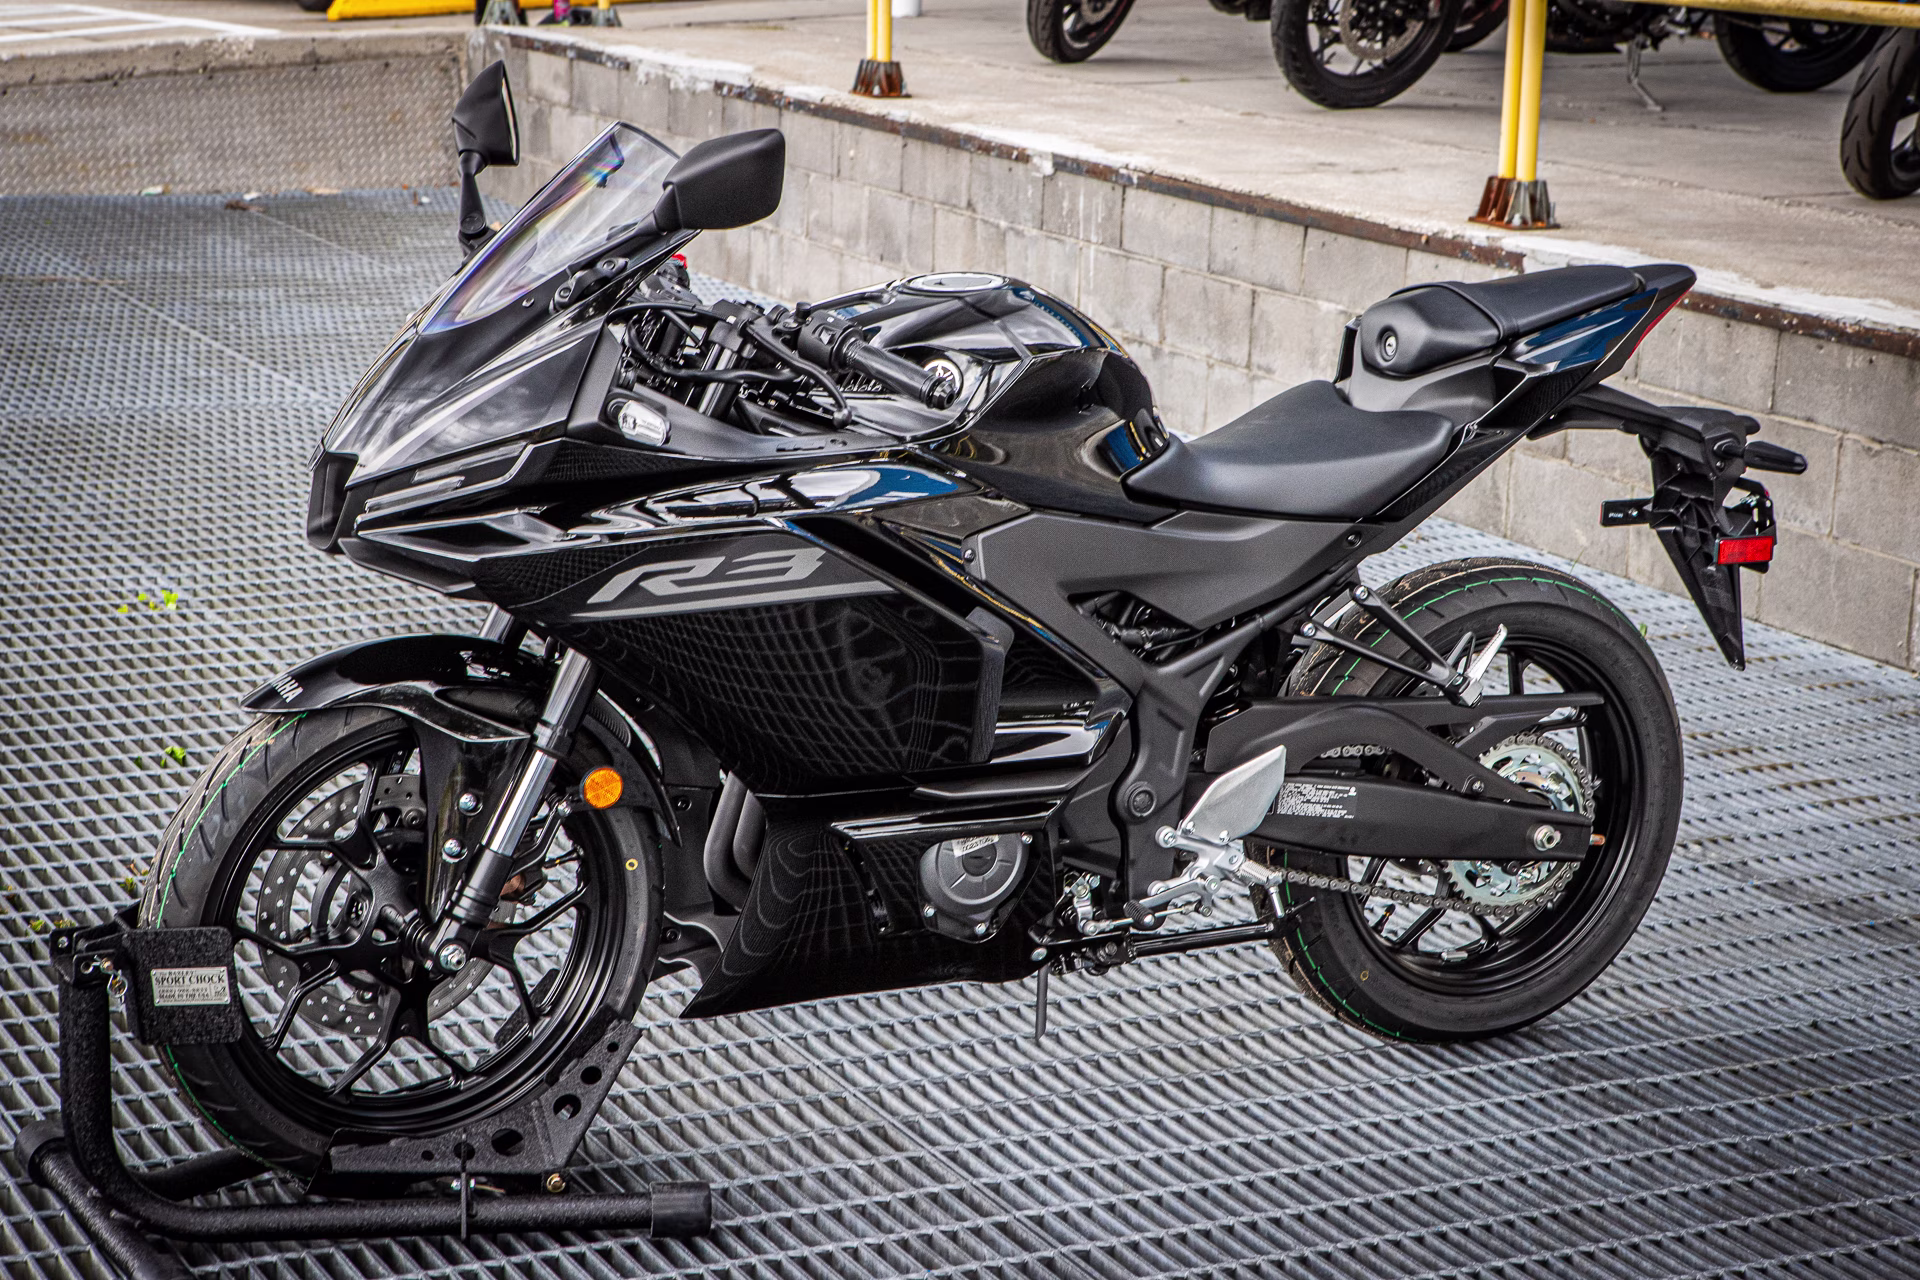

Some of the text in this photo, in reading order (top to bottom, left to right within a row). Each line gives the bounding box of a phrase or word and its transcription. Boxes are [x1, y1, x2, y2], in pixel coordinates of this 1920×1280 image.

[587, 547, 826, 604] R3
[155, 974, 225, 985] SPORT CHOCK
